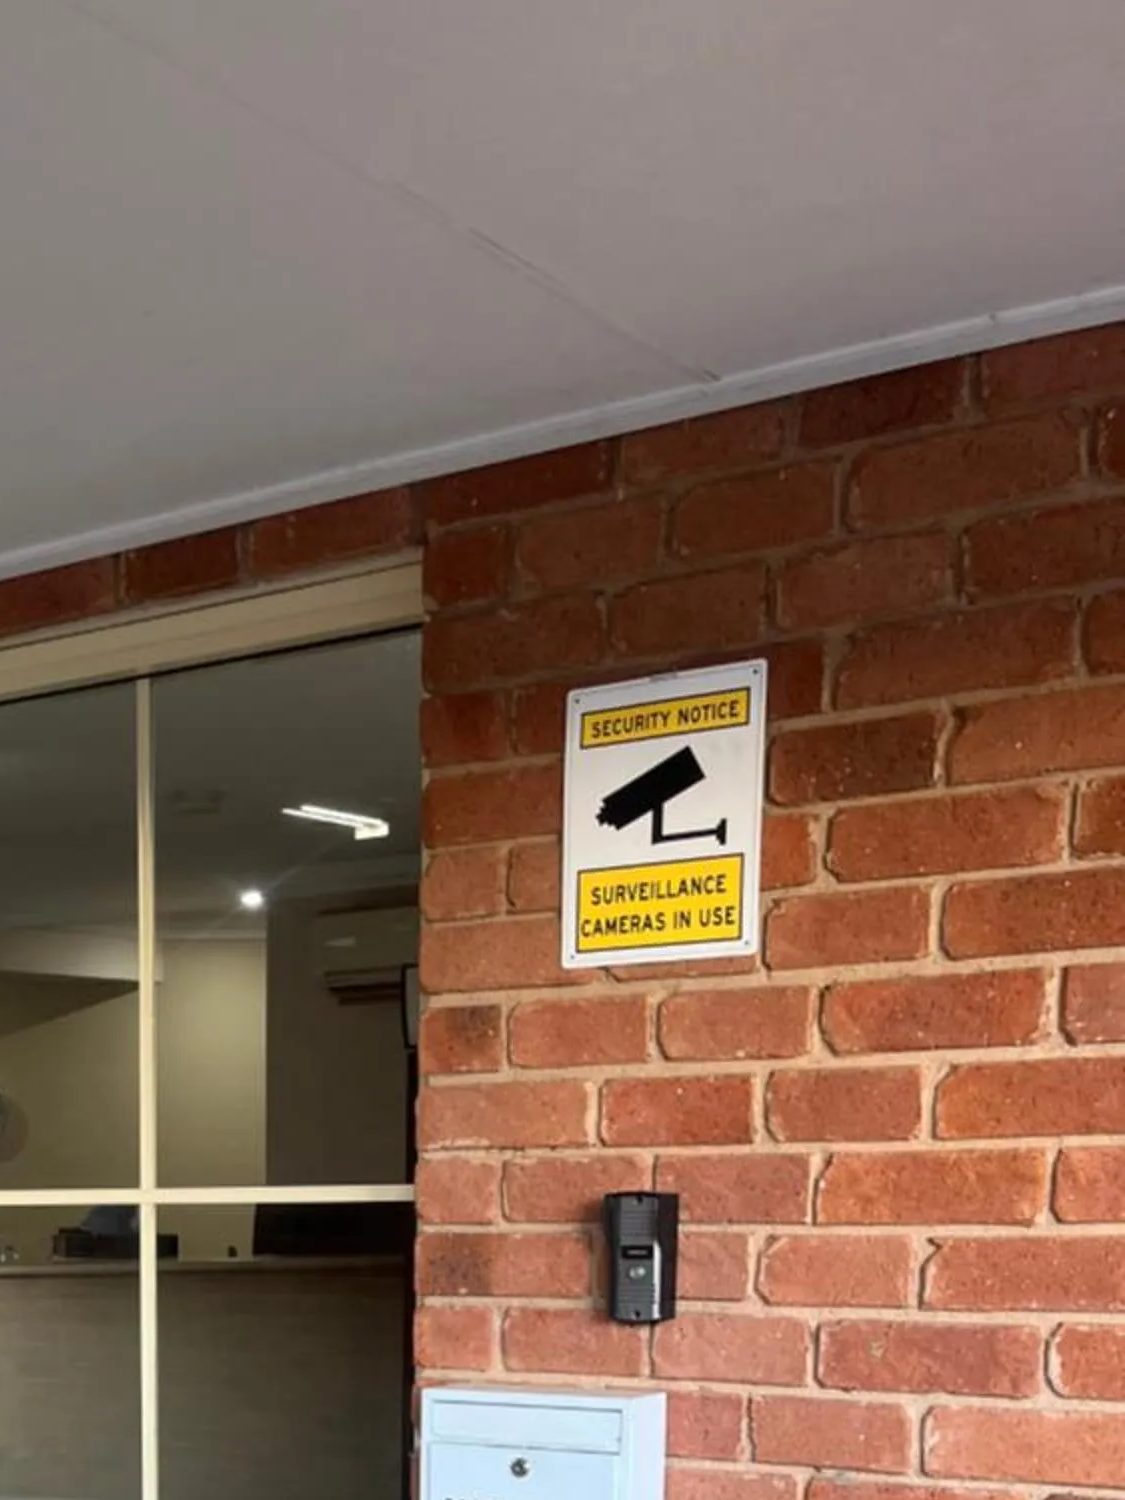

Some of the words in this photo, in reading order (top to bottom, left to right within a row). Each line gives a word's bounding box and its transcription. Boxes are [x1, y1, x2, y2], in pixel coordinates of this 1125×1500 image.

[591, 710, 671, 738] SECURITY
[678, 700, 739, 725] NOTICE
[591, 873, 727, 906] SURVEILLANCE
[581, 911, 667, 938] CAMERAS
[673, 910, 691, 929] IN
[699, 906, 736, 928] USE
